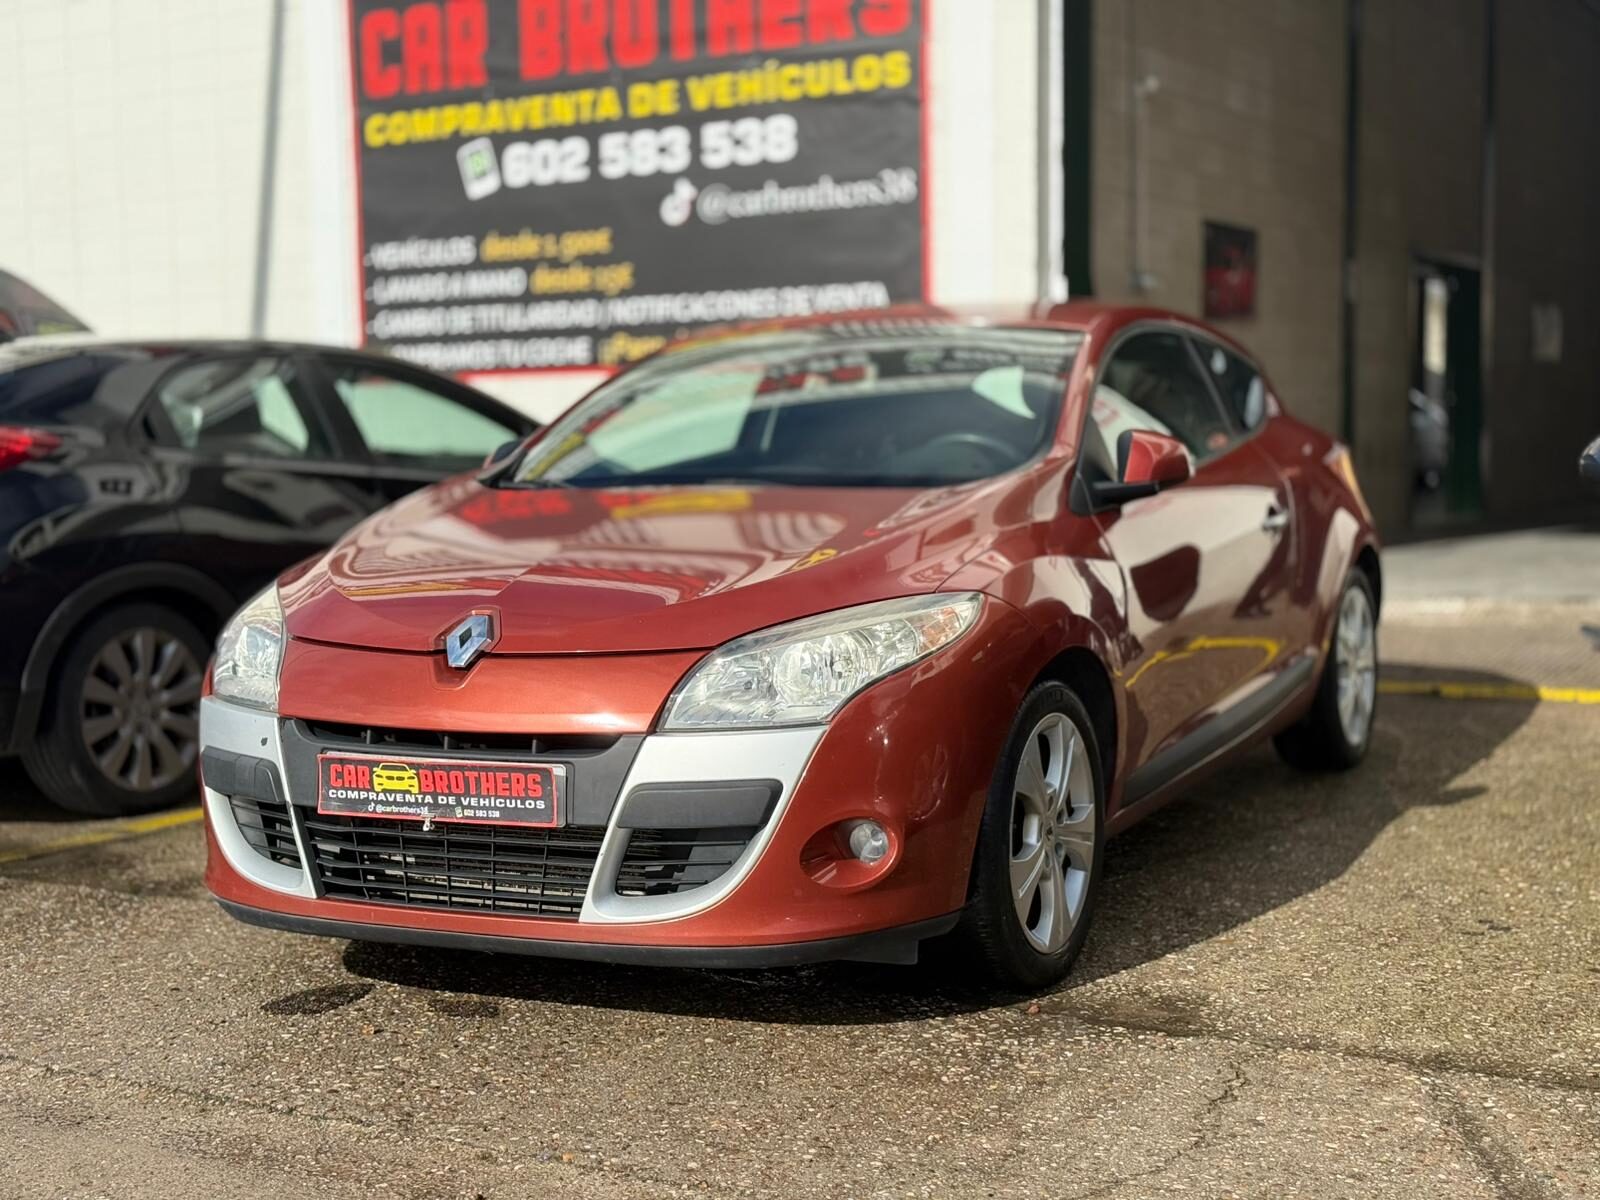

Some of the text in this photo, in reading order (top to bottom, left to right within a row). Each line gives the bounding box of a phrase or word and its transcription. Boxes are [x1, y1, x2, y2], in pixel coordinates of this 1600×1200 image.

[361, 0, 489, 97] CAR
[364, 50, 911, 147] COMPRAVENTA DE VEHÍCULOS
[502, 114, 798, 188] 602 583 538
[480, 229, 541, 262] desde
[529, 261, 592, 295] desde
[330, 764, 543, 798] CAR BROTHERS
[329, 789, 545, 809] COMPRAVENTA DE VEHÍCULOS
